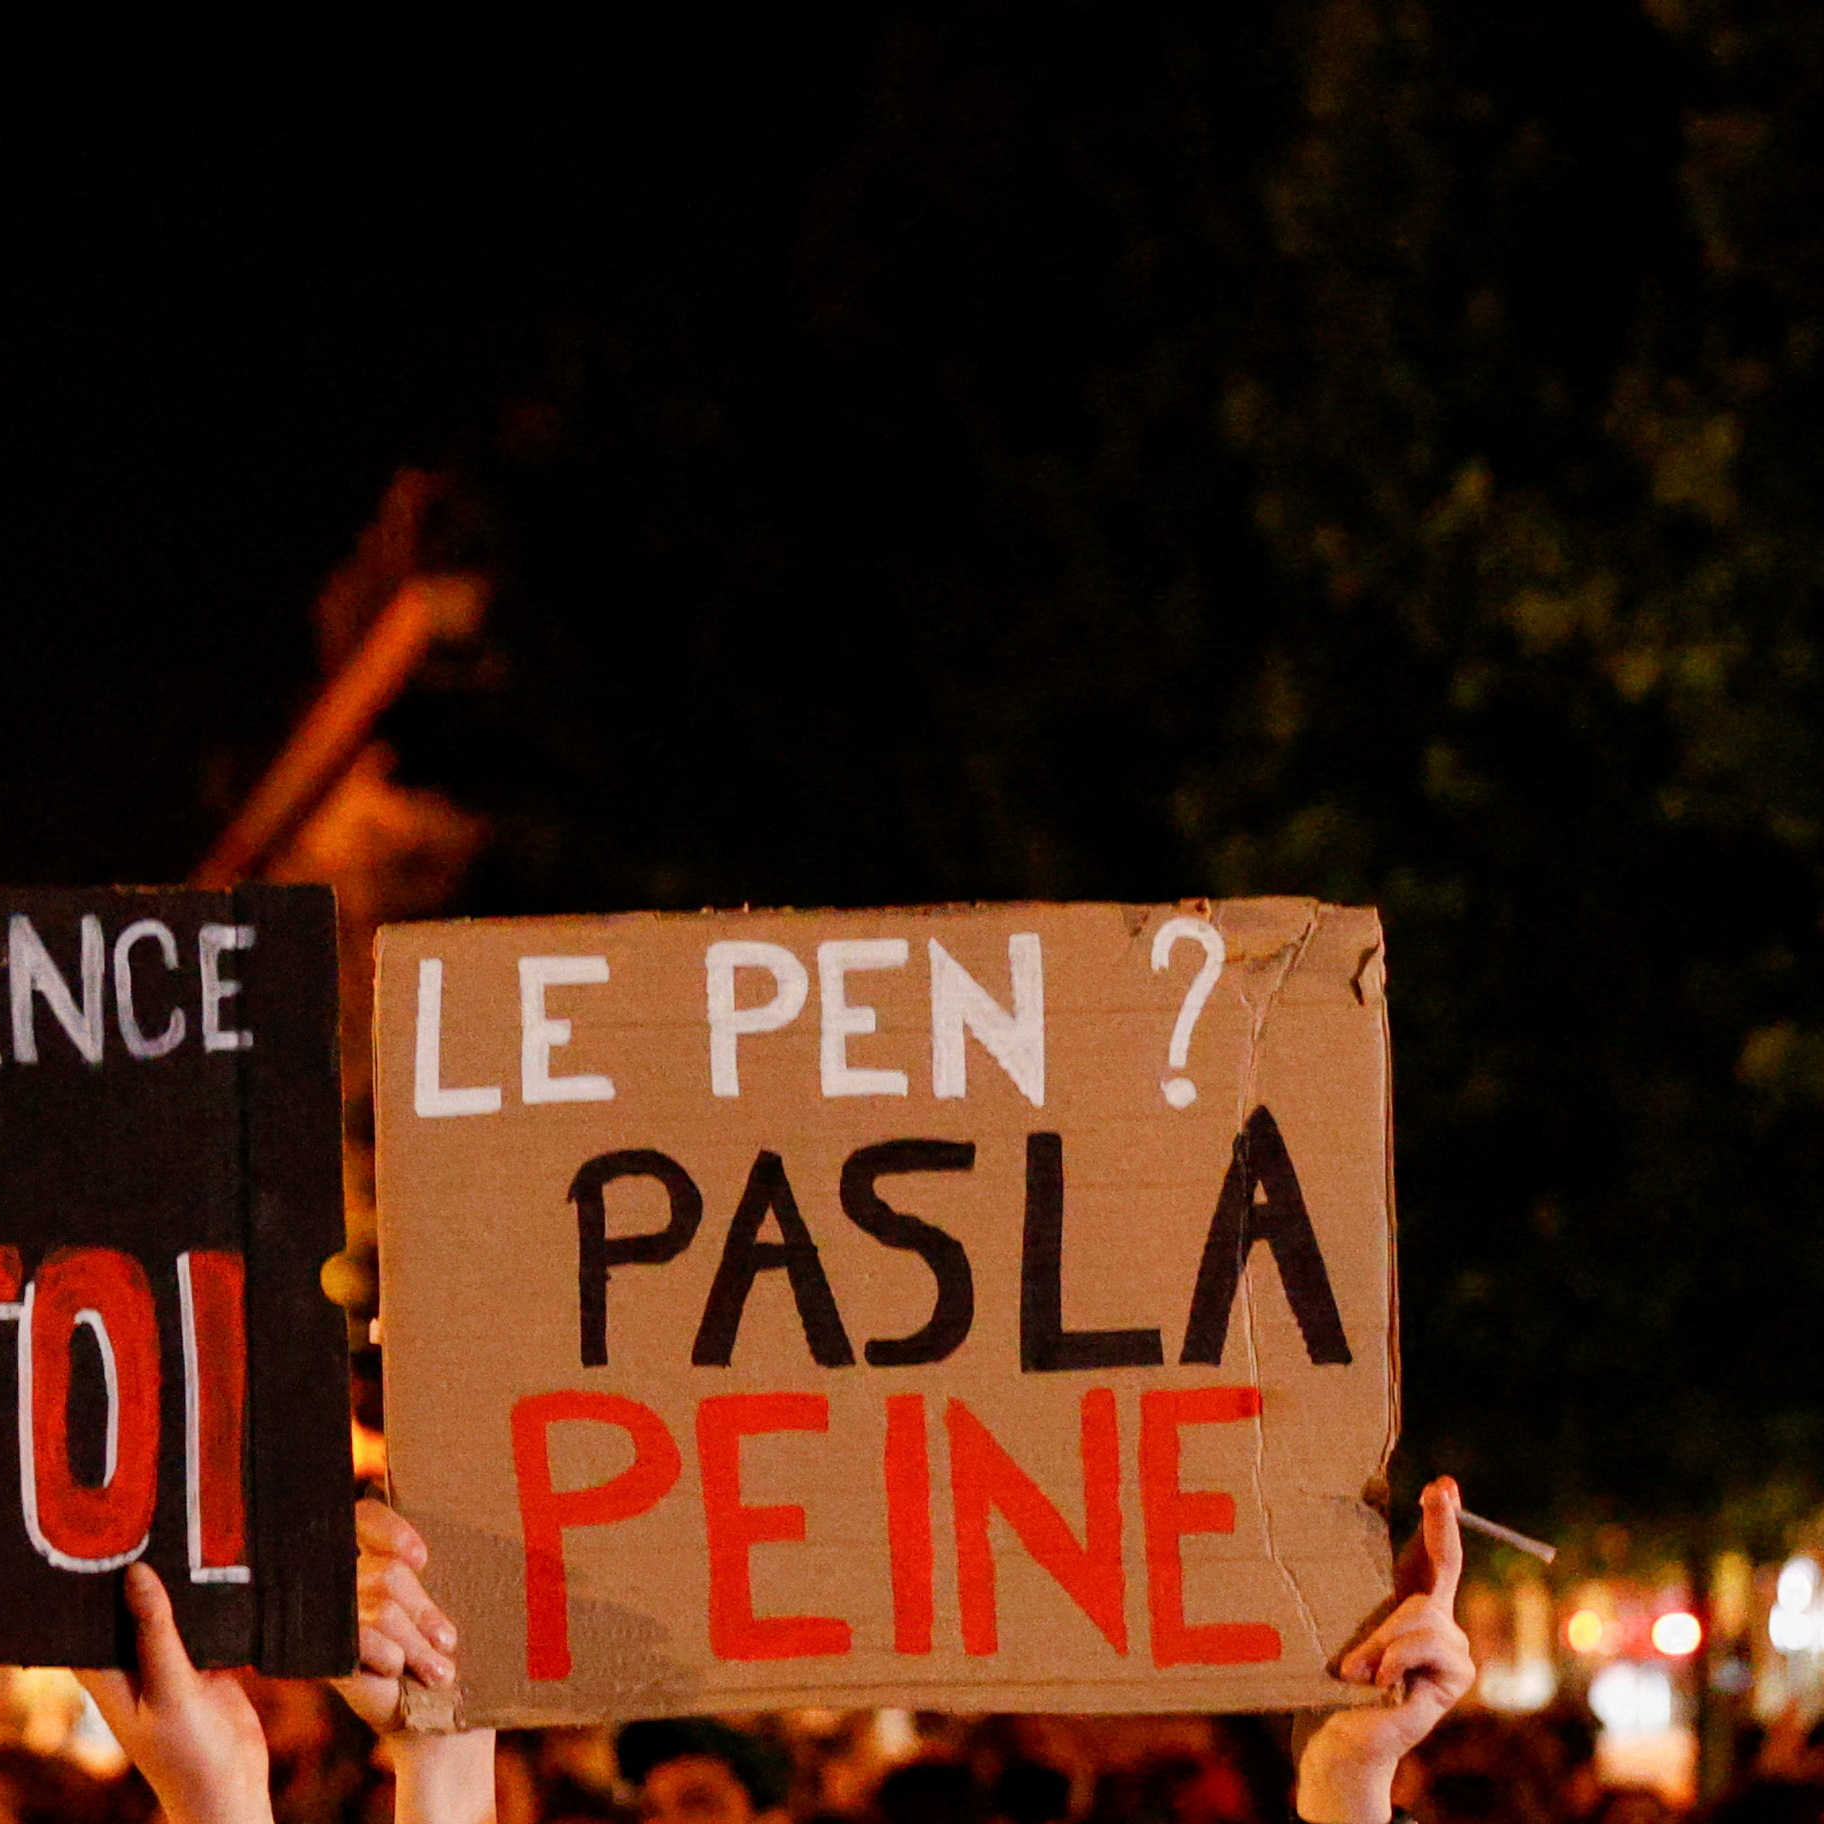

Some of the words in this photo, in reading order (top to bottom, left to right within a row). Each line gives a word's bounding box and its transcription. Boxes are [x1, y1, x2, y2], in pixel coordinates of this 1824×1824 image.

[414, 956, 616, 1118] LE
[706, 932, 1046, 1108] PEN
[1150, 916, 1224, 1108] ?
[567, 1140, 976, 1368] PAS
[1020, 1104, 1353, 1372] LA
[509, 1386, 1282, 1682] PEINE
